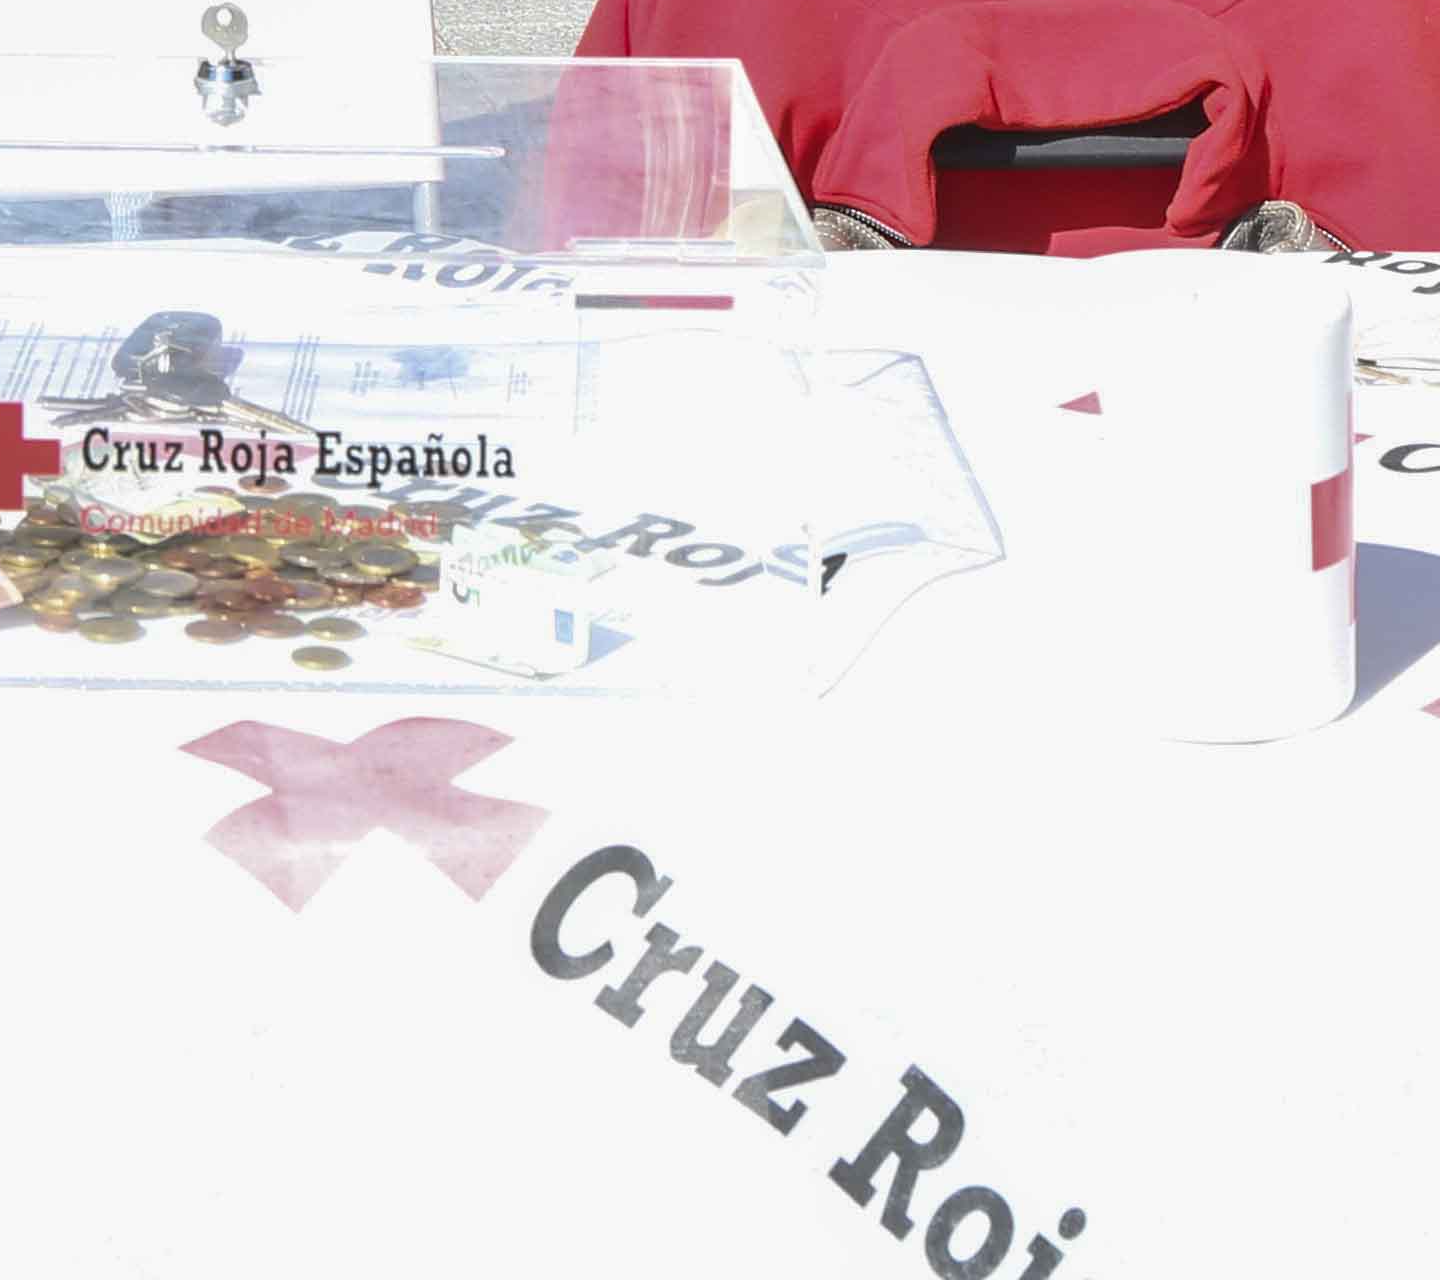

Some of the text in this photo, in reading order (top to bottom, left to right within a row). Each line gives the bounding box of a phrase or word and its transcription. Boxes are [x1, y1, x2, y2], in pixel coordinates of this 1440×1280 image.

[81, 427, 517, 489] Cruz Roja Española
[79, 504, 439, 541] Comunidad de Madrid
[529, 844, 848, 1138] Cruz
